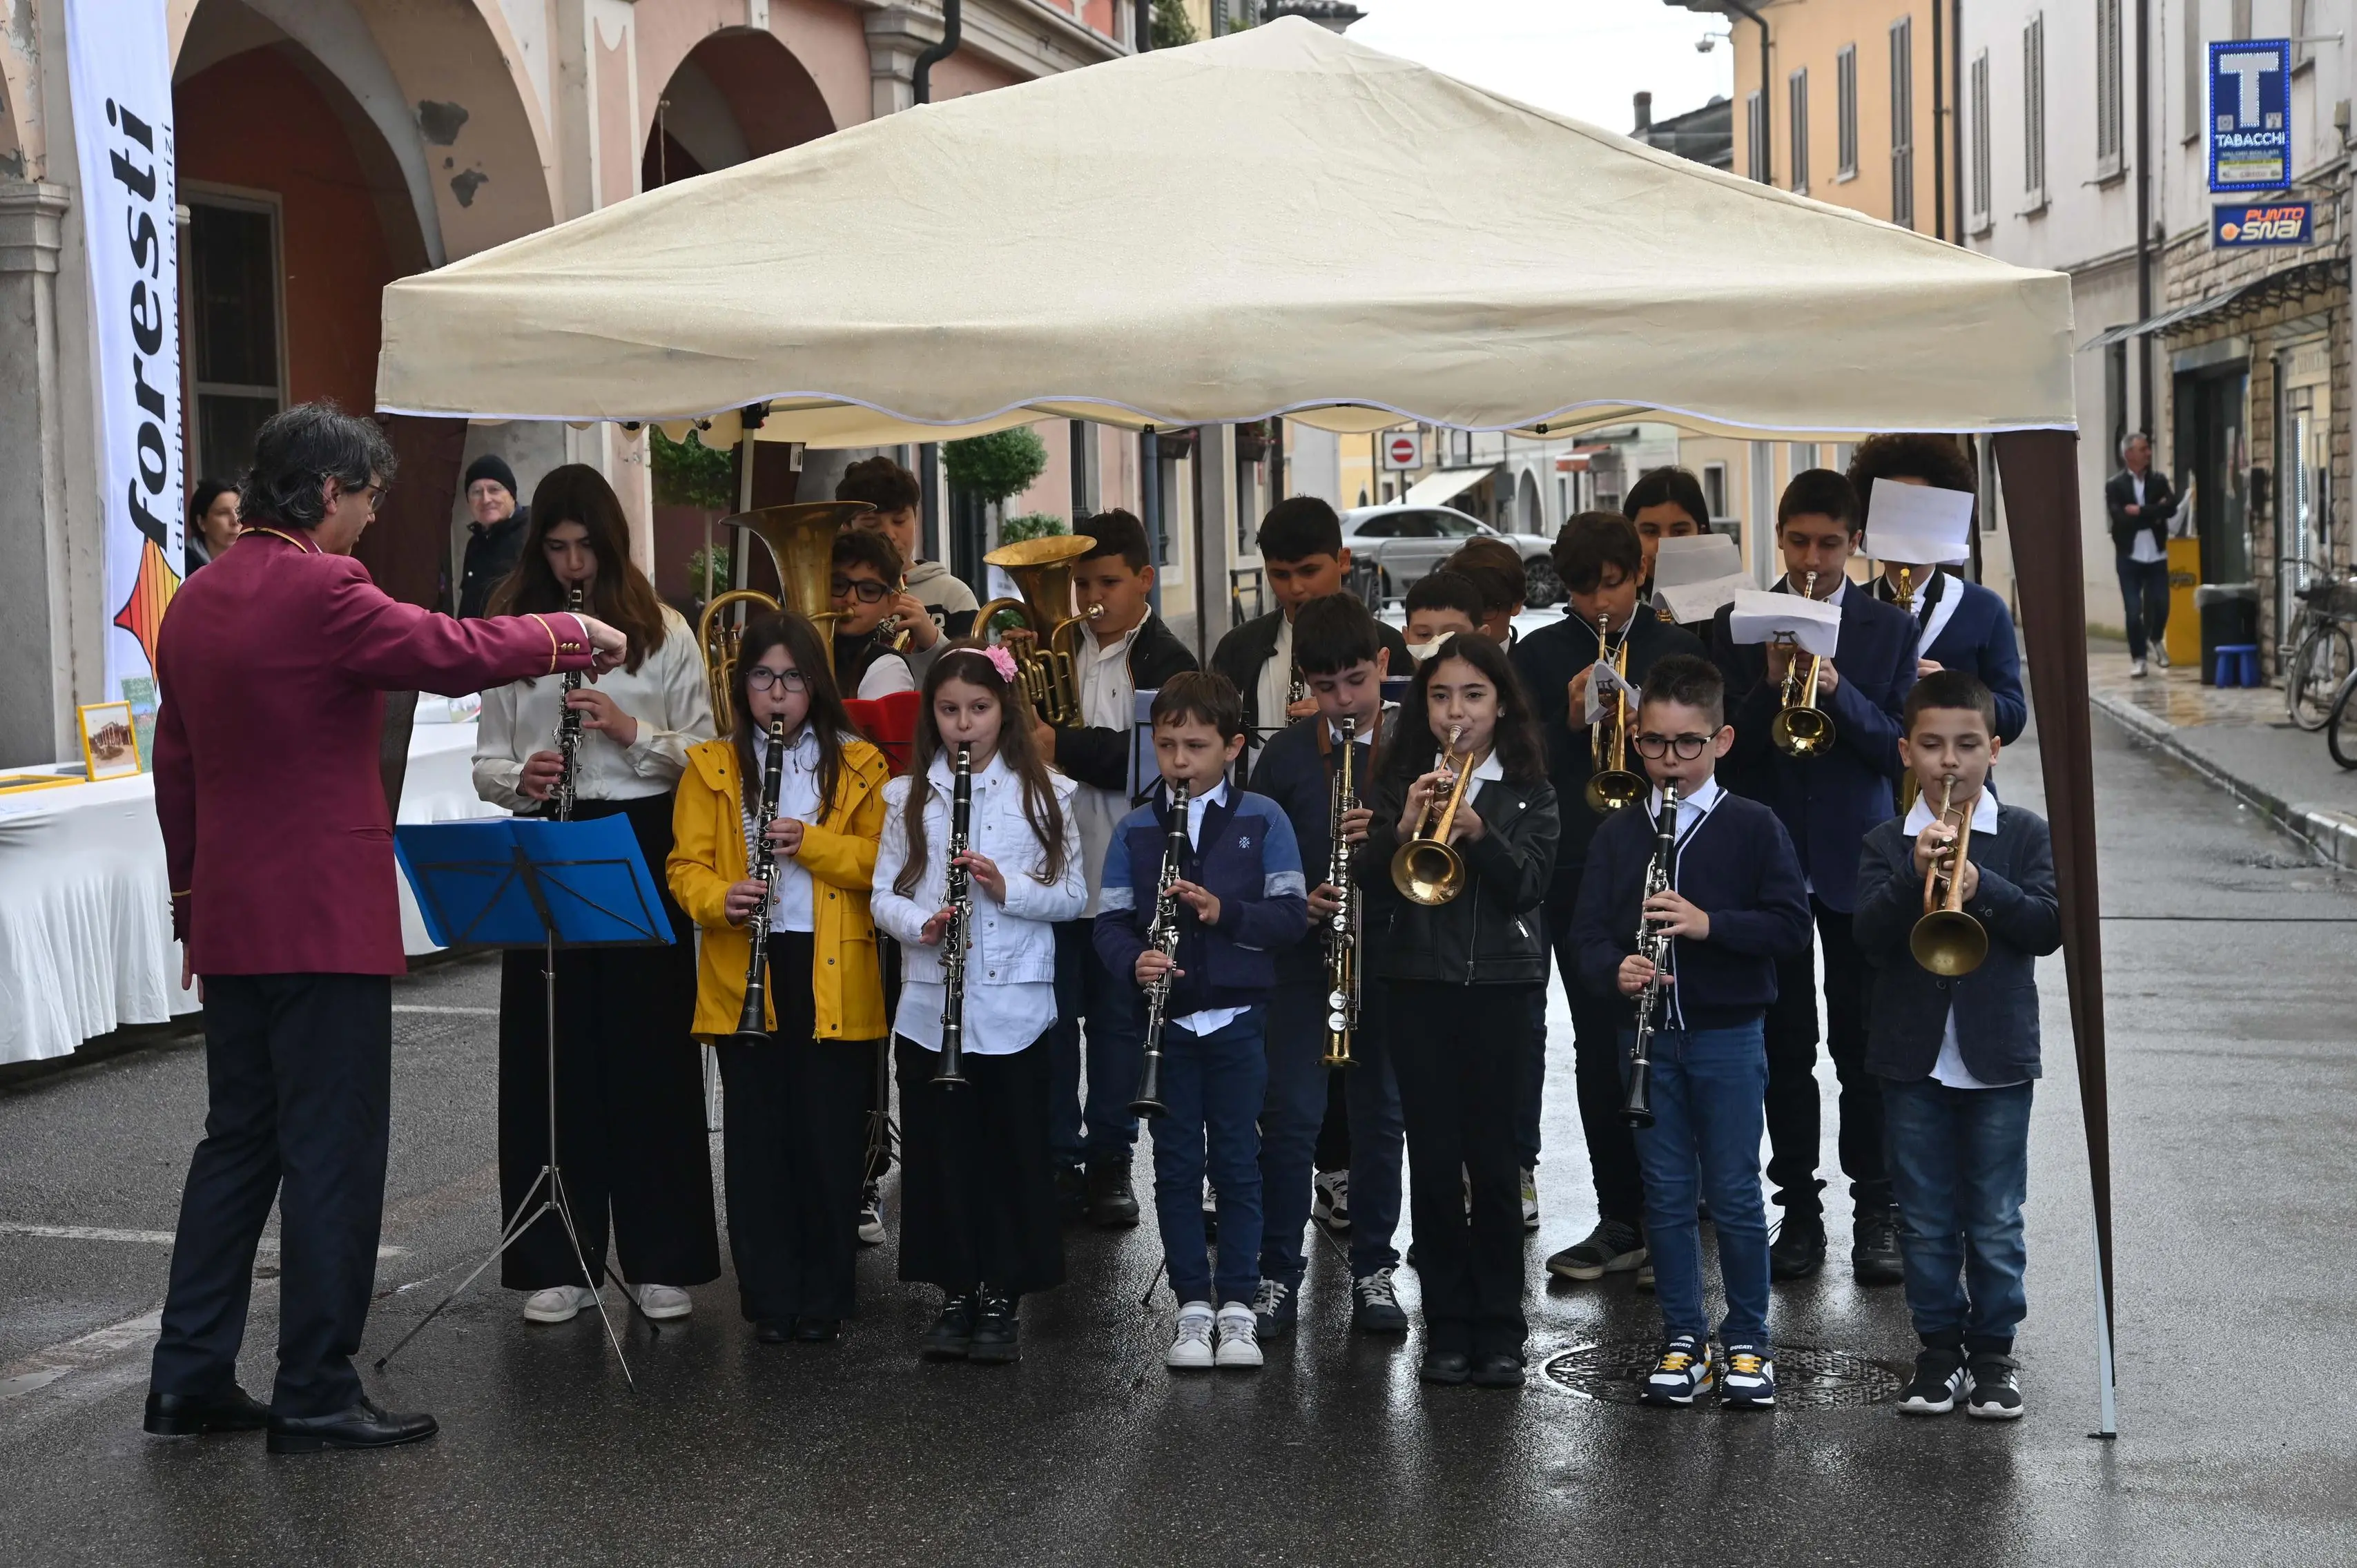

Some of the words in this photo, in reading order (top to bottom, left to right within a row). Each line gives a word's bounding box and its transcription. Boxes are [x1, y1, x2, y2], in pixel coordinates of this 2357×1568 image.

[2220, 52, 2279, 128] T
[2215, 131, 2285, 148] TABACCHI
[162, 122, 175, 267] laterizi
[2245, 207, 2305, 222] PUNTO
[106, 97, 167, 553] foresti
